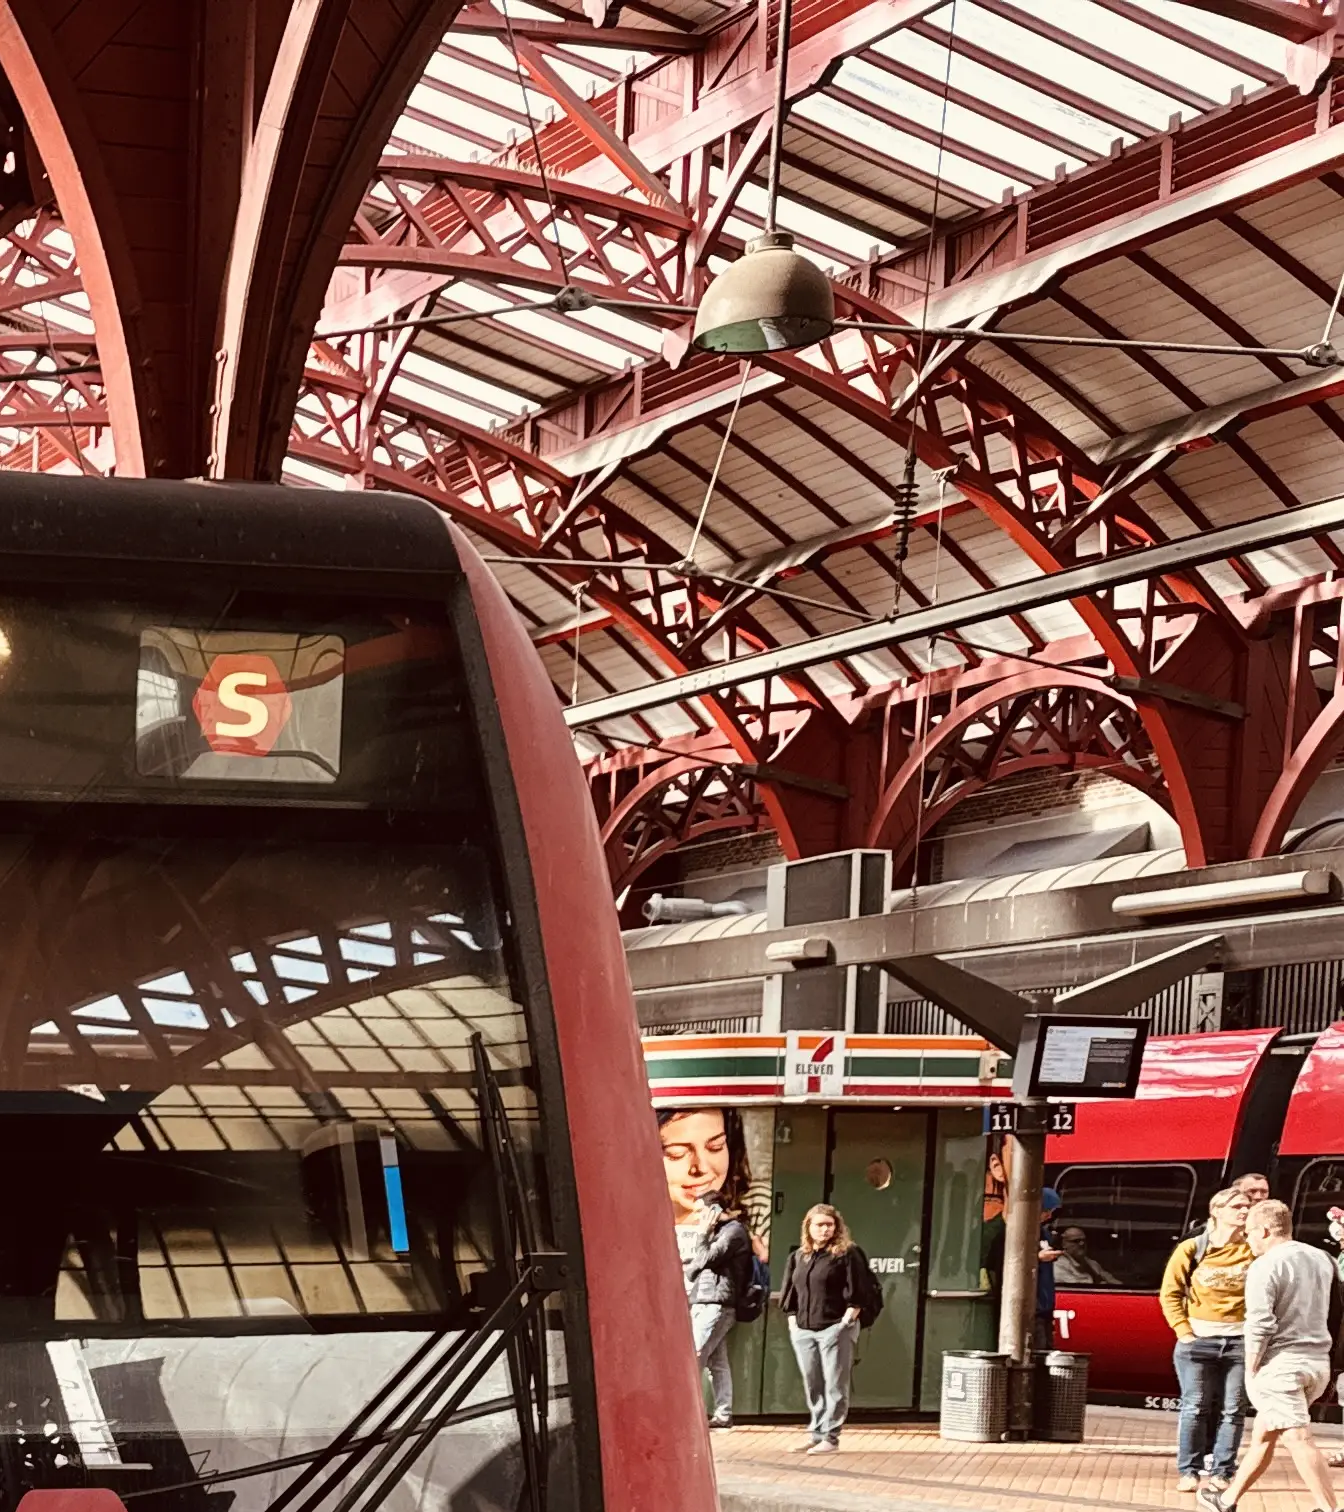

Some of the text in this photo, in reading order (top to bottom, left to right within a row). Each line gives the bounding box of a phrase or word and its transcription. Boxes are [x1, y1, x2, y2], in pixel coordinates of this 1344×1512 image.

[215, 671, 269, 738] S
[992, 1113, 1013, 1131] 11
[1052, 1113, 1073, 1130] 12
[1144, 1396, 1160, 1409] SC
